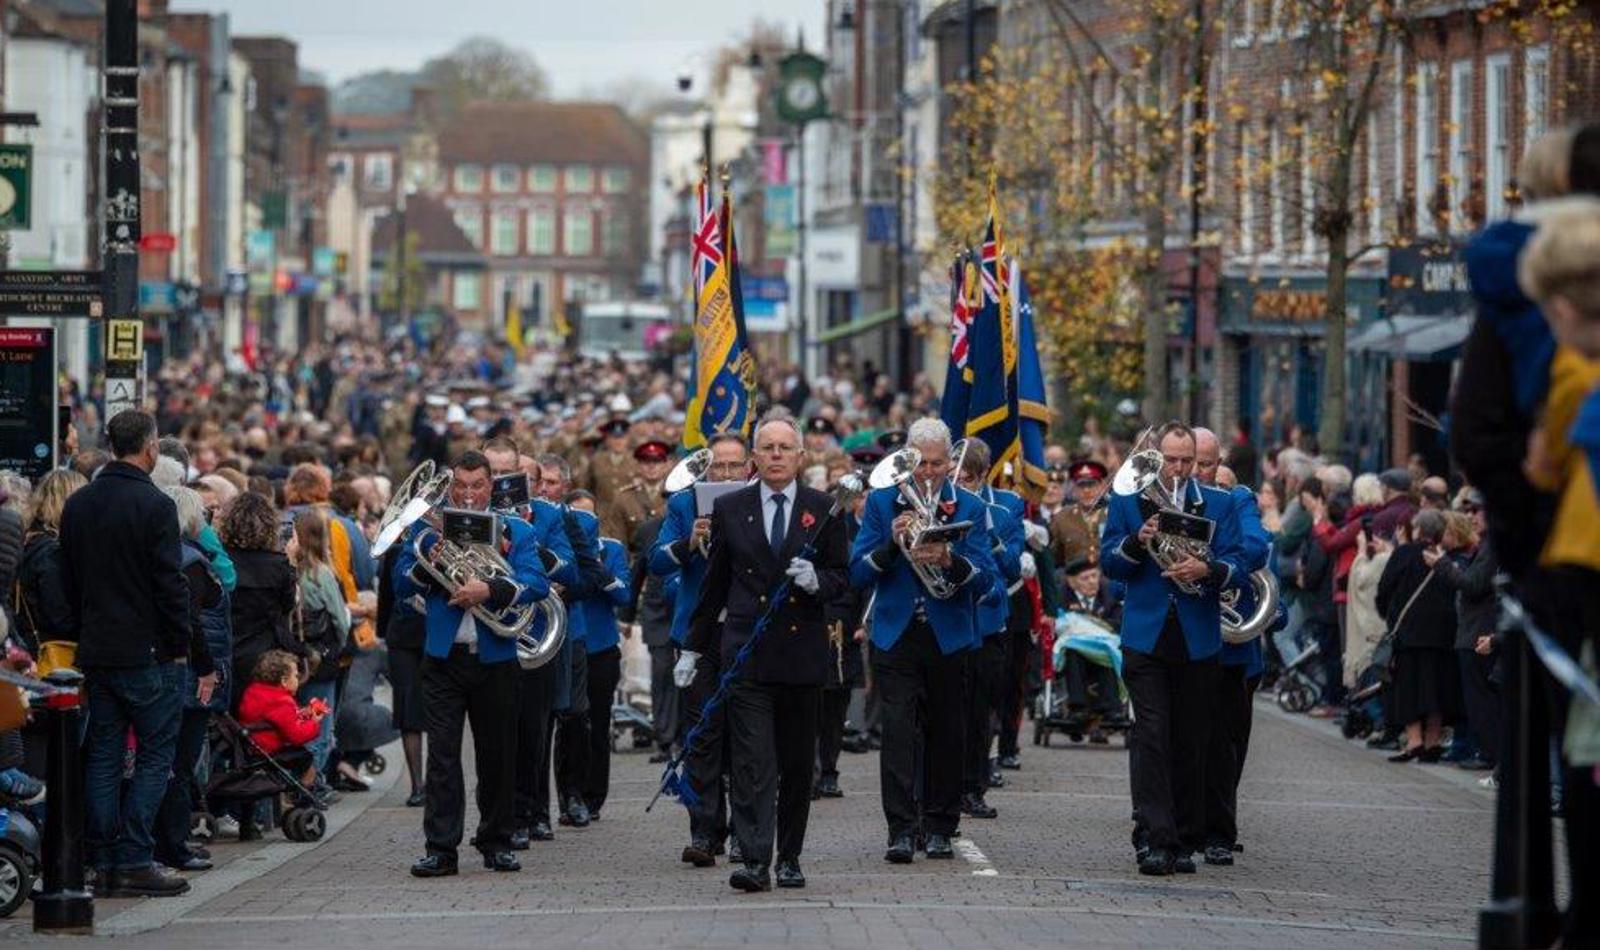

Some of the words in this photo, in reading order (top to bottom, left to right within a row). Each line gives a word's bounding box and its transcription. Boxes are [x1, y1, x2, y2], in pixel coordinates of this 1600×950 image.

[4, 275, 54, 283] SALVATION
[61, 275, 86, 283] ARMY
[26, 304, 62, 312] CENTRE
[113, 324, 138, 355] H
